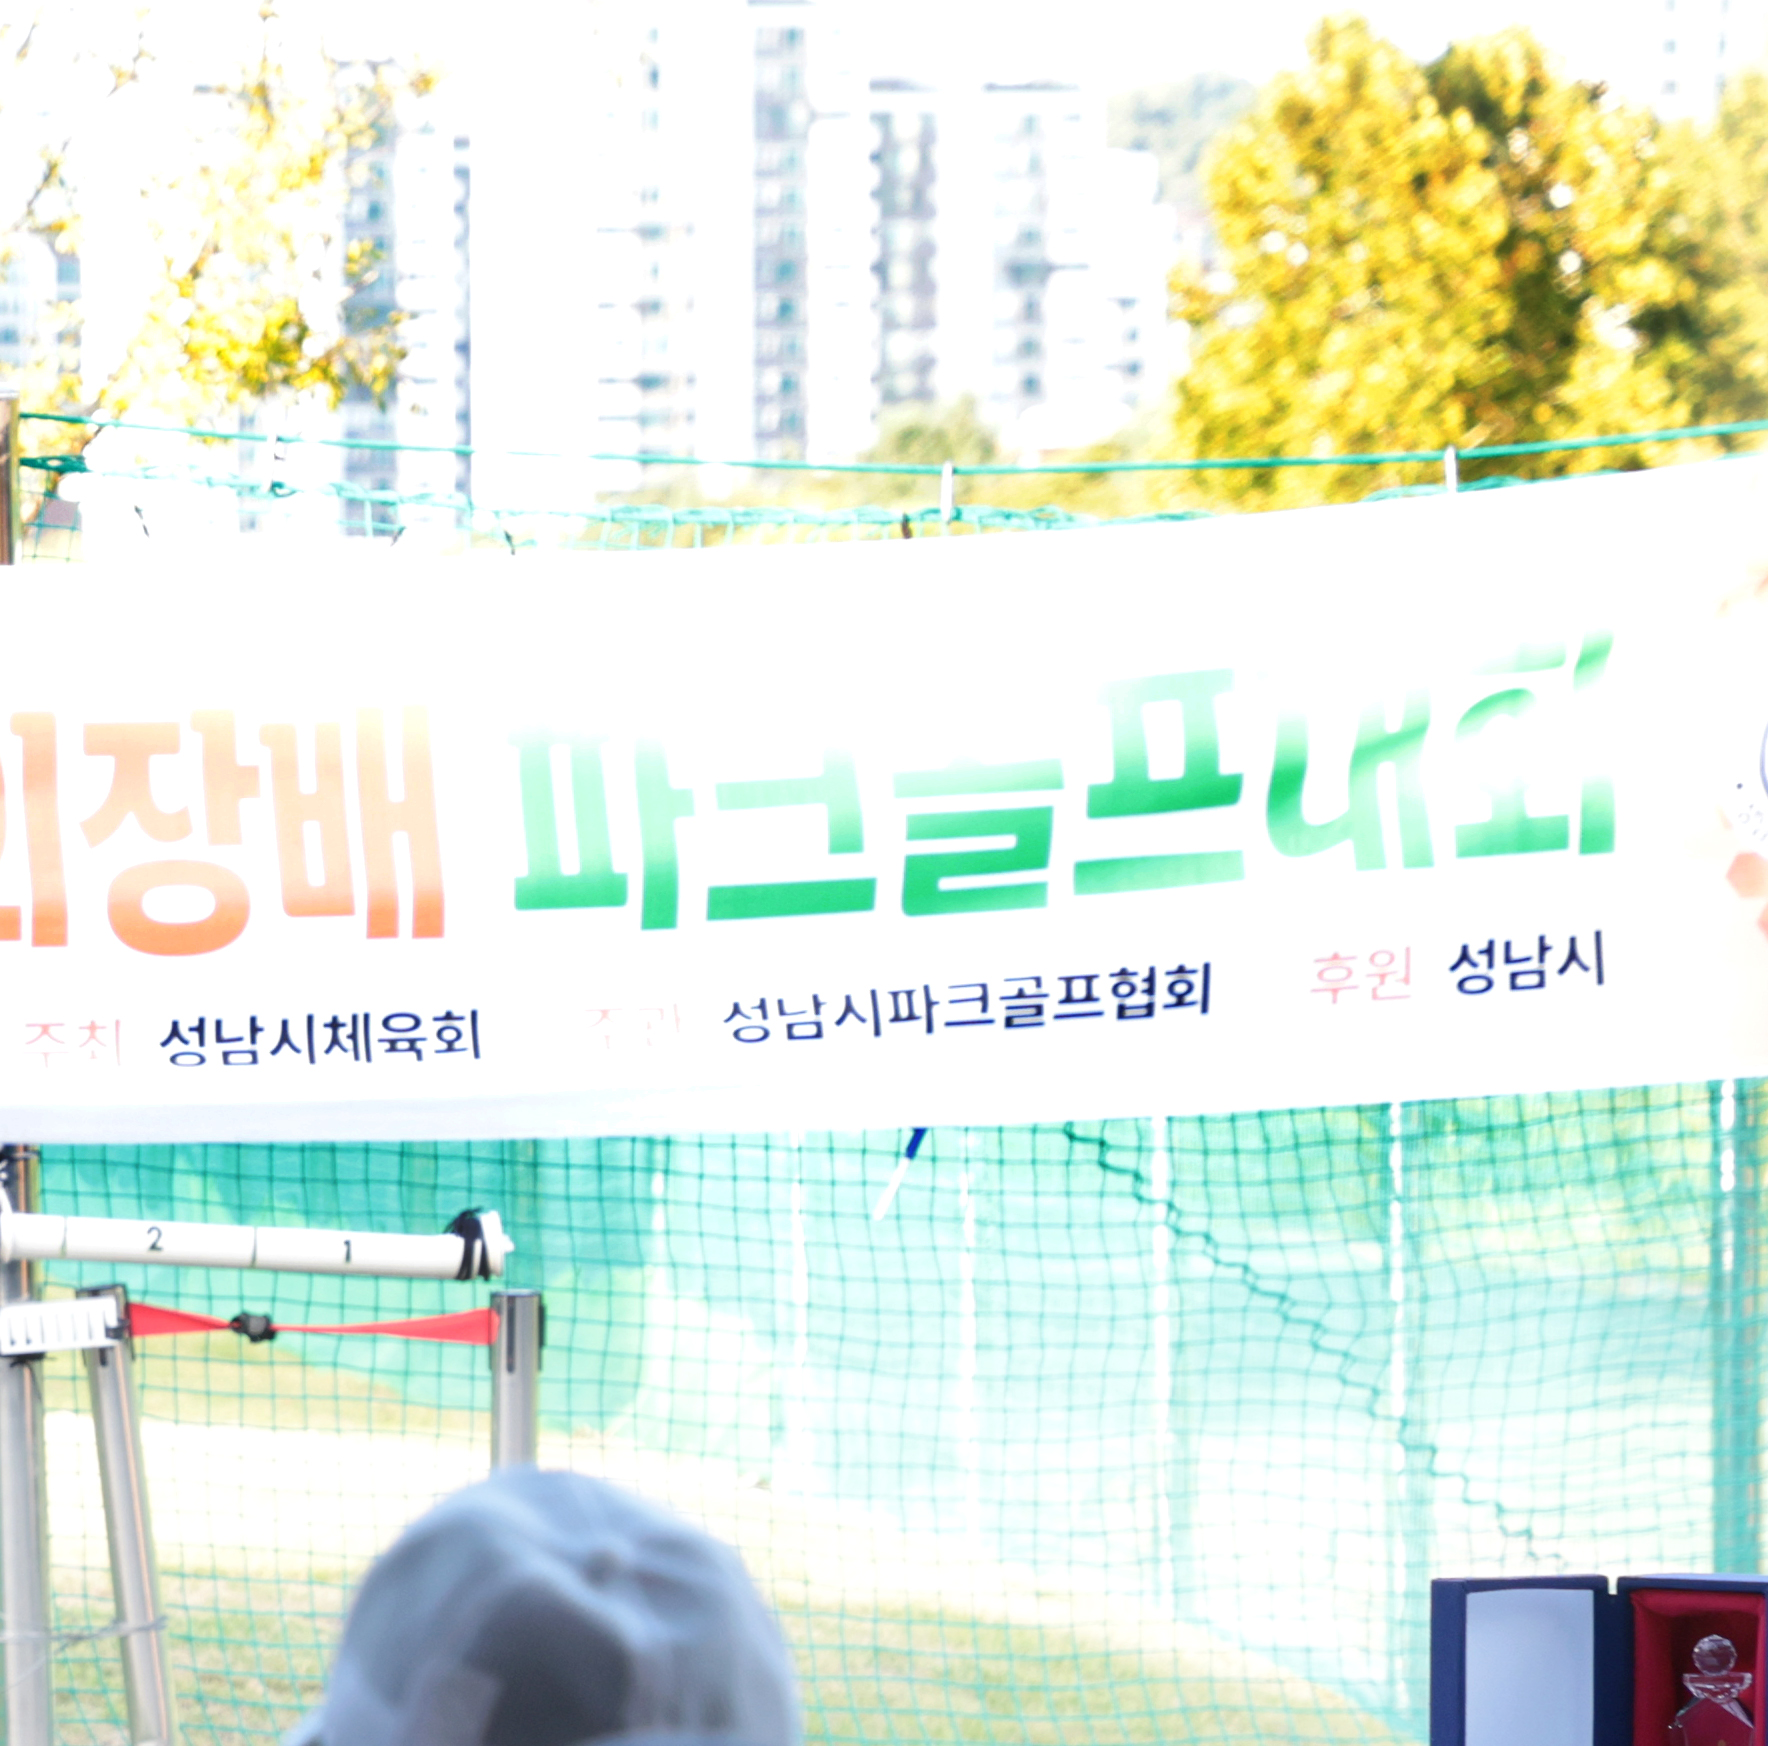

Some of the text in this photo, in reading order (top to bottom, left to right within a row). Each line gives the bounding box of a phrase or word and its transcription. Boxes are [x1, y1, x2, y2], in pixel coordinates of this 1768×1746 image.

[160, 1008, 482, 1068] 성남시체육회
[723, 961, 1211, 1045] 성남시파크골프협회
[1310, 946, 1413, 1005] 후원
[1449, 929, 1605, 995] 성남시
[146, 1225, 163, 1252] 2
[343, 1239, 352, 1264] 1
